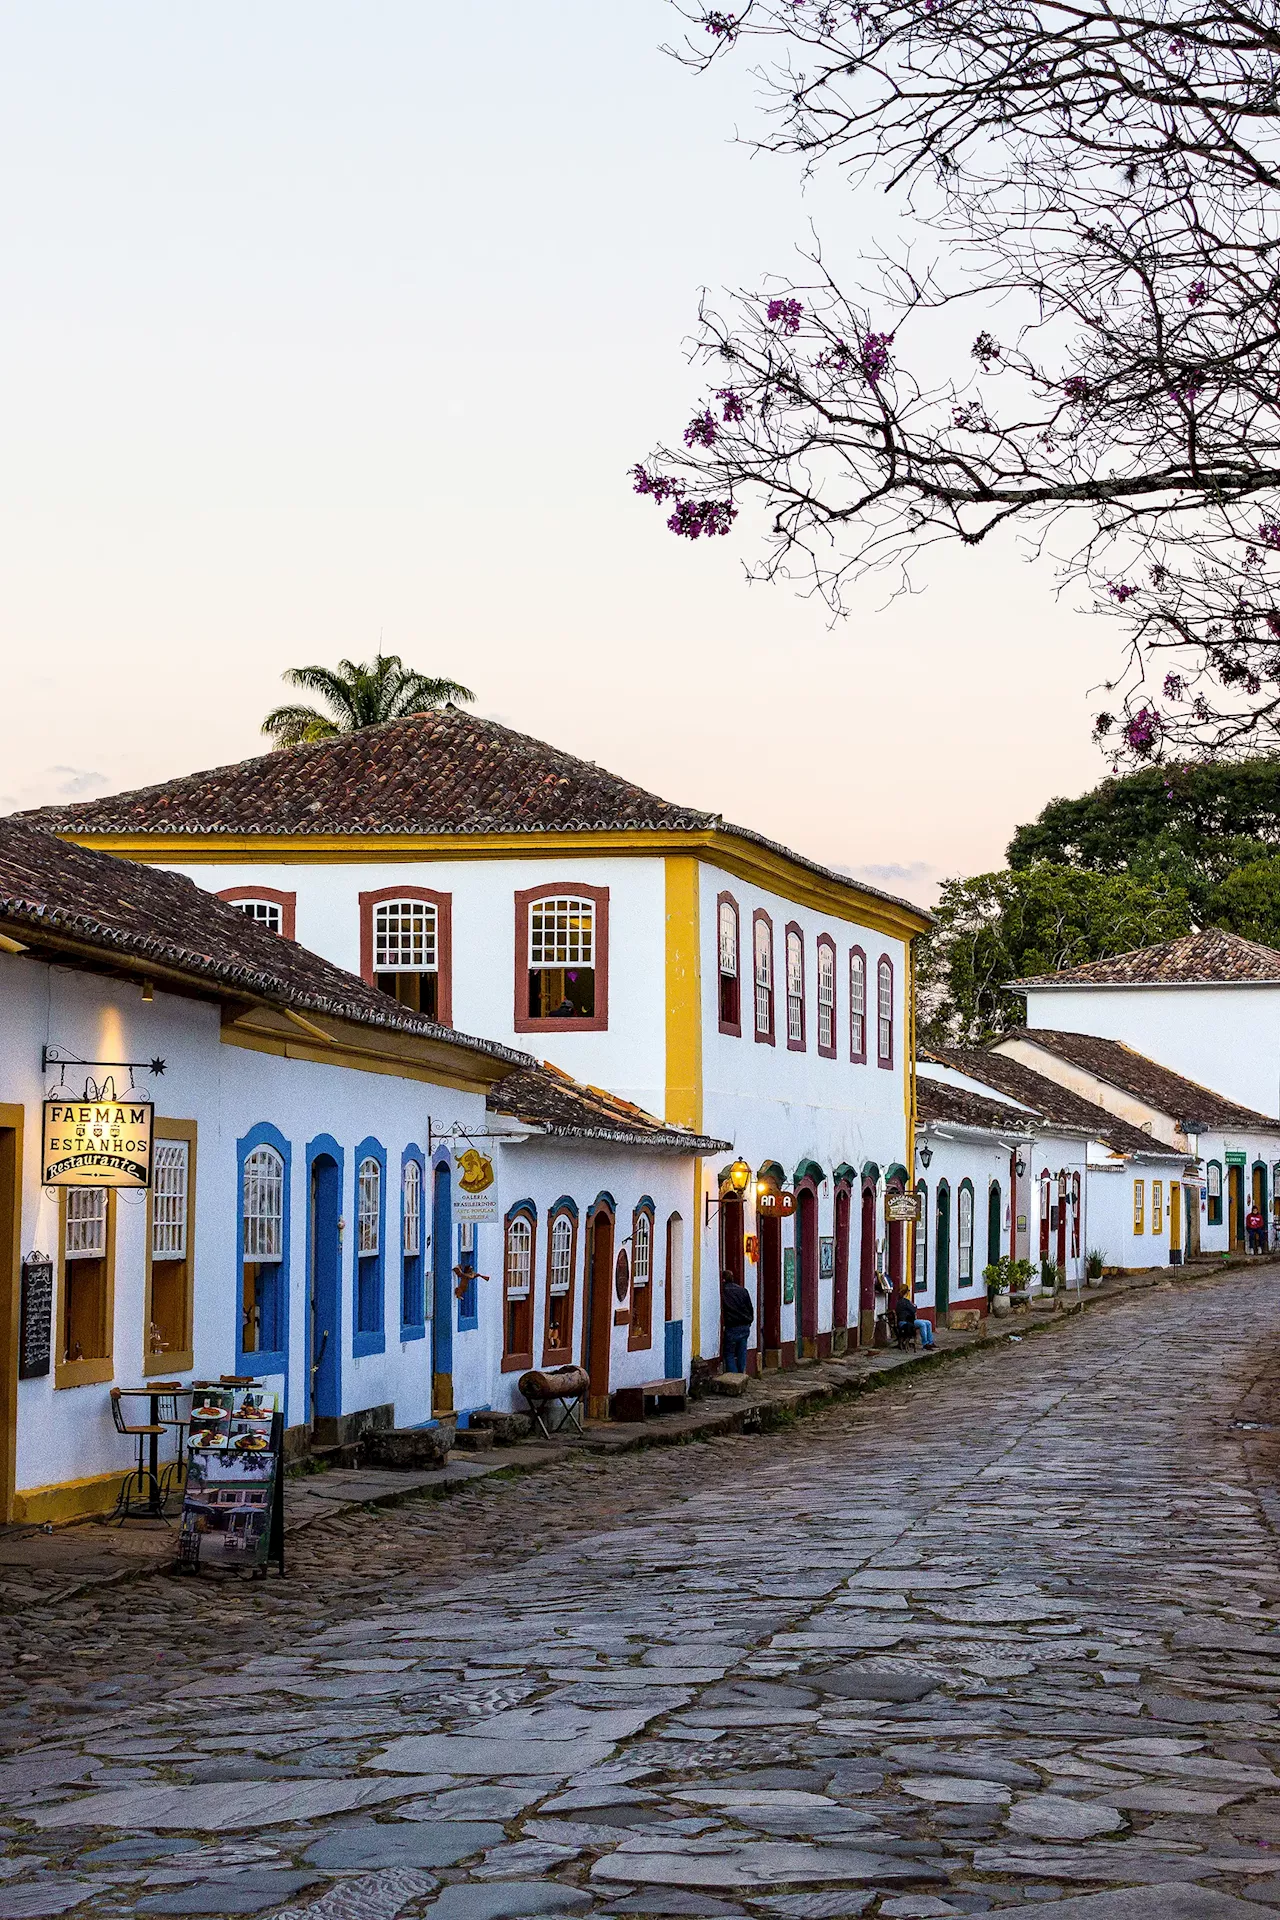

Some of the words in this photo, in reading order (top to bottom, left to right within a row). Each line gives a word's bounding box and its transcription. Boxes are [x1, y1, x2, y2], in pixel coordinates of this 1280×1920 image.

[51, 1107, 146, 1124] FAEMAM
[50, 1138, 147, 1152] ESTANHOS
[48, 1154, 140, 1179] Restaurante
